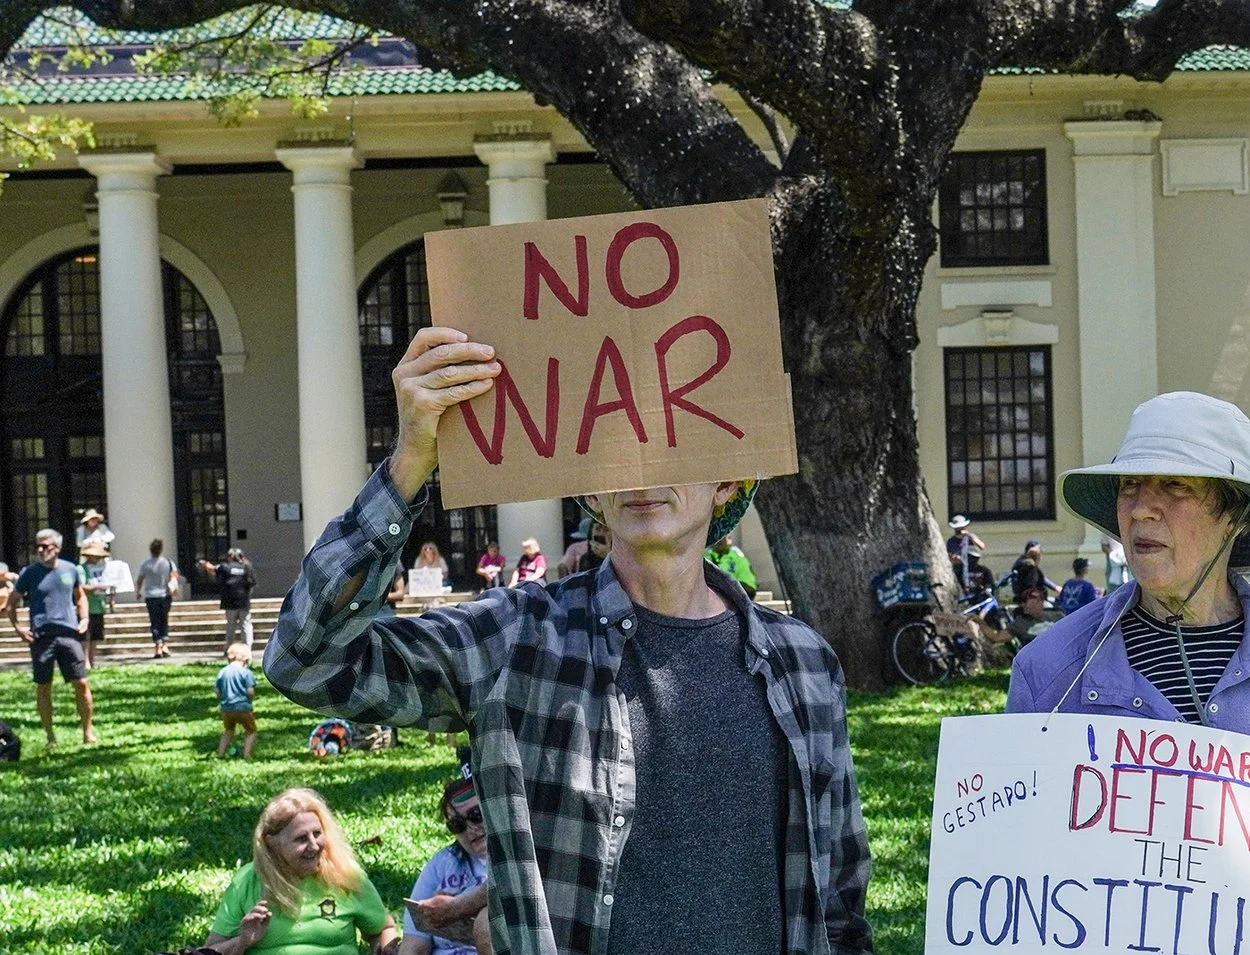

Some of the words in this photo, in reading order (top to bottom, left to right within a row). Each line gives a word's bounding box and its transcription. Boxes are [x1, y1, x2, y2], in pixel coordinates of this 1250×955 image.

[523, 222, 680, 320] NO
[458, 315, 746, 465] WAR
[1115, 728, 1179, 766] NO
[943, 770, 1037, 834] GESTAPO!
[957, 773, 984, 798] NO
[1134, 838, 1209, 884] THE
